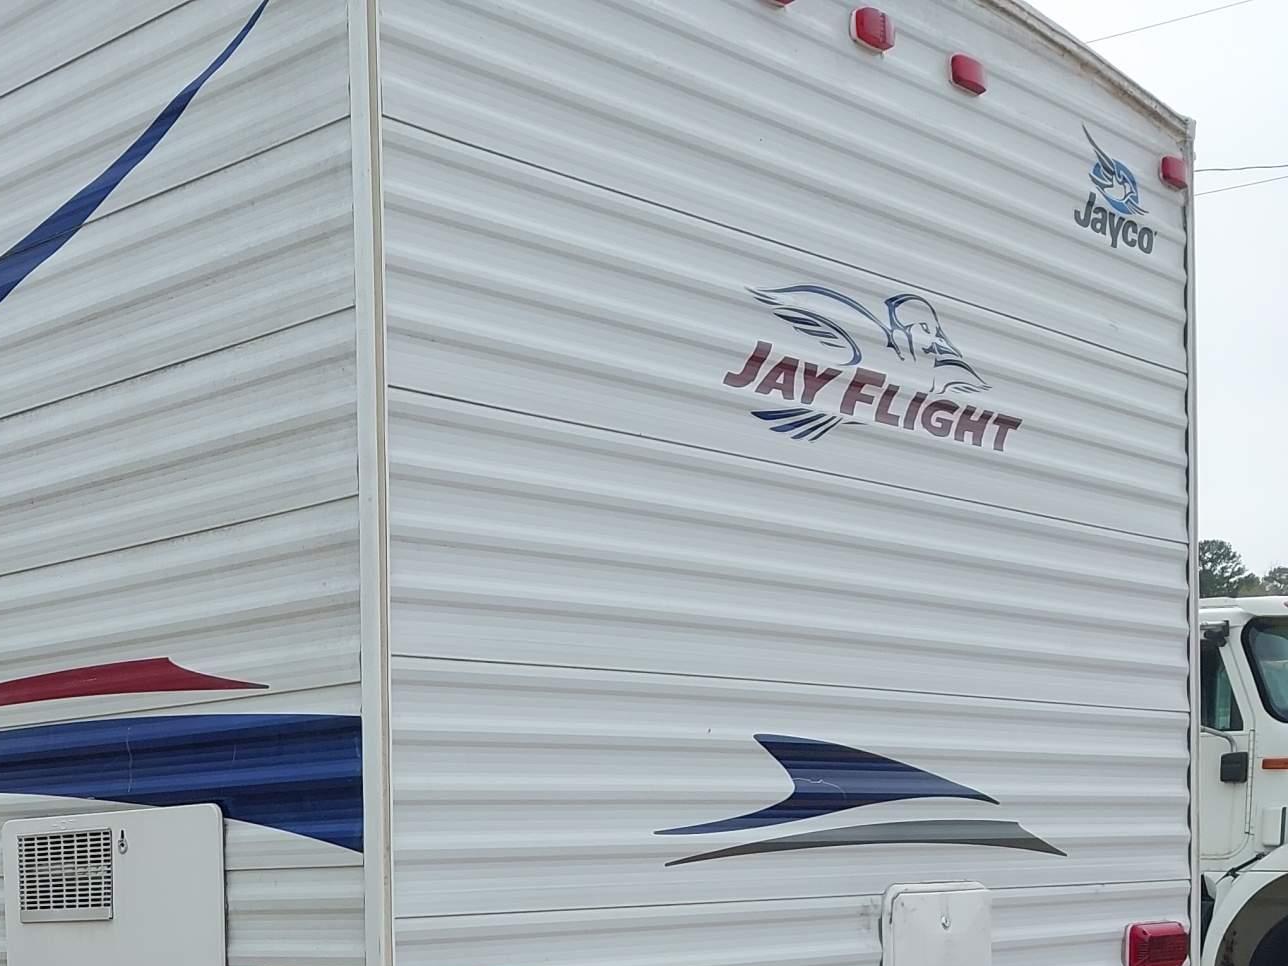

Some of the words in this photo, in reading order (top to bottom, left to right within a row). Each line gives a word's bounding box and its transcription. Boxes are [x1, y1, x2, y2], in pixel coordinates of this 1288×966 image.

[1074, 192, 1154, 254] Jayco
[723, 341, 843, 405] JAY
[839, 367, 1023, 453] FLIGHT
